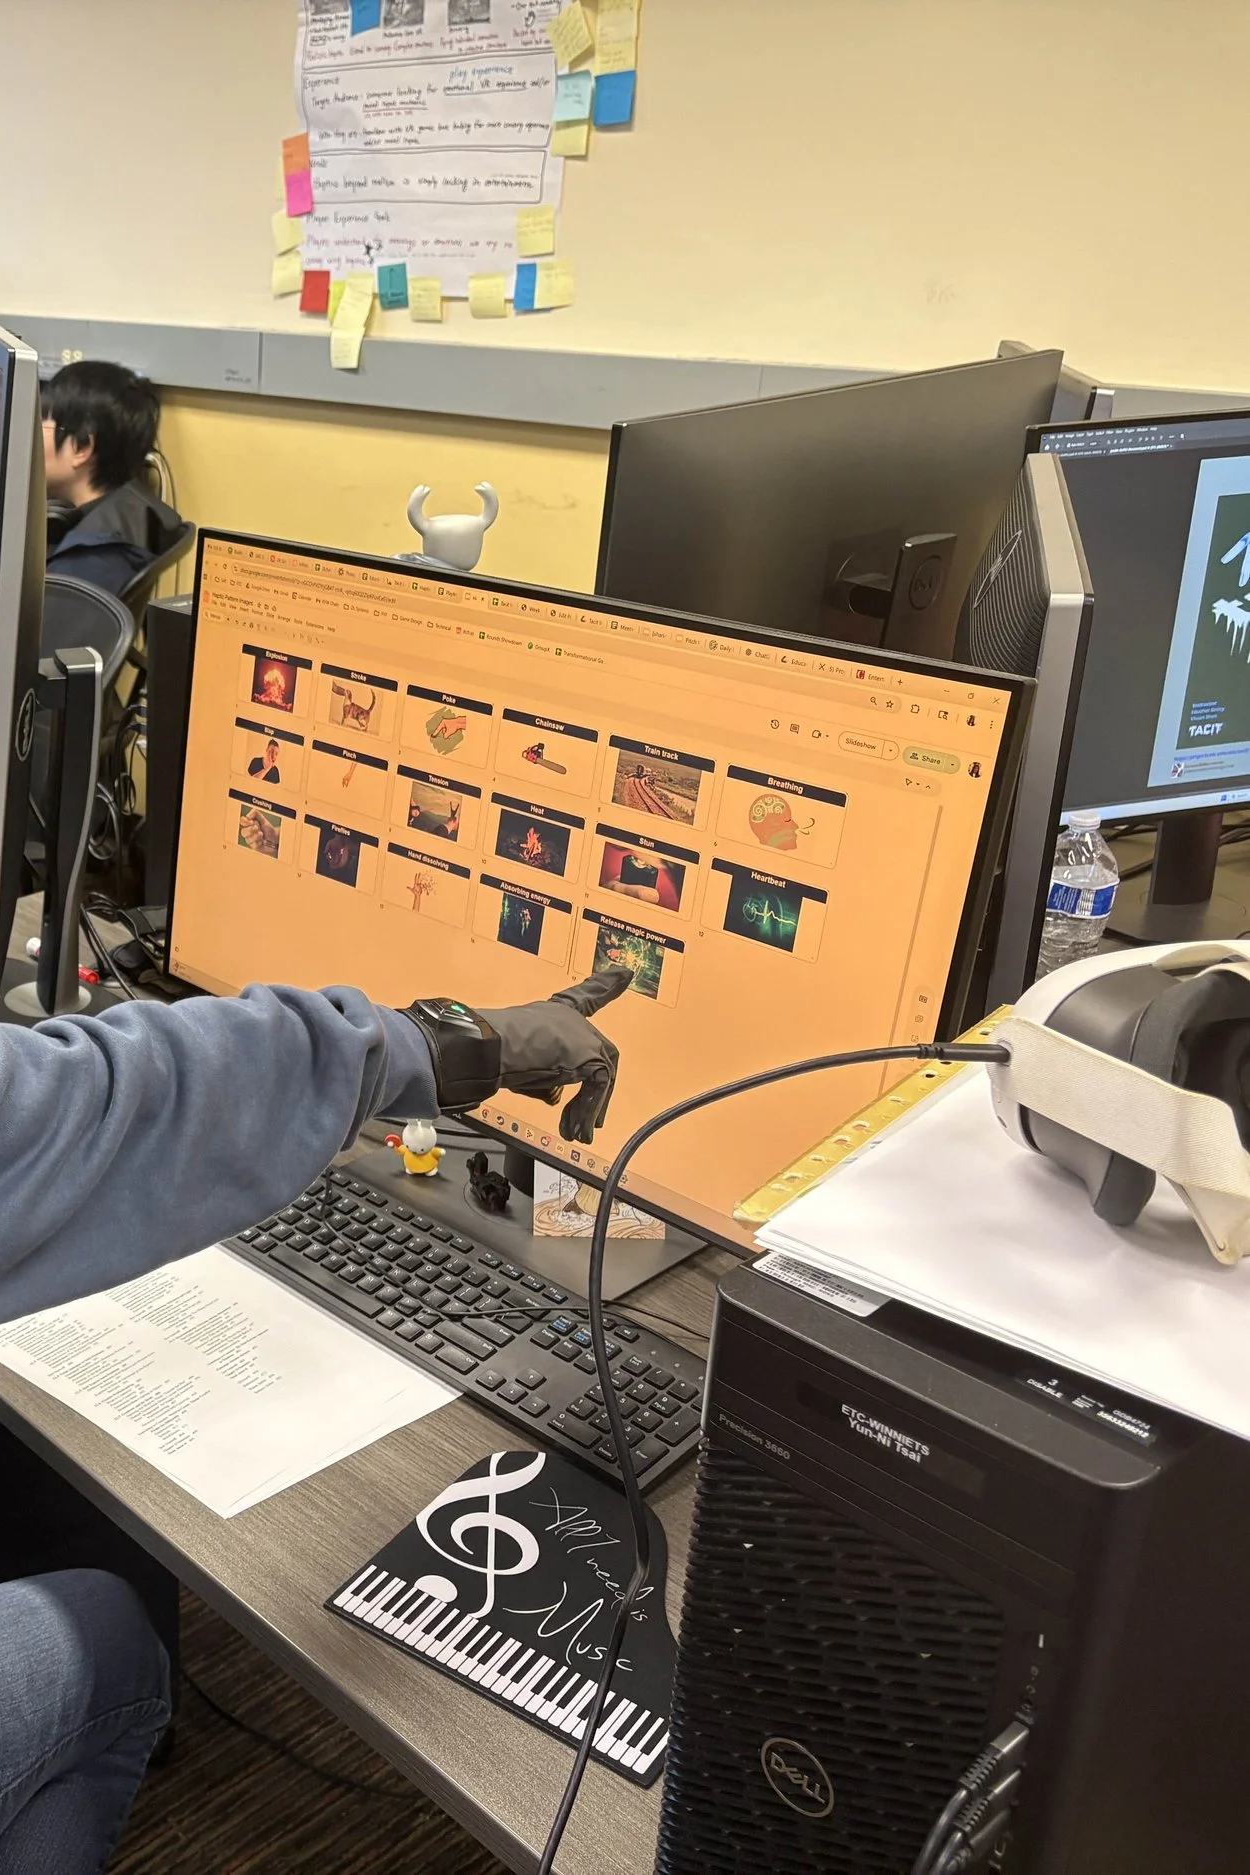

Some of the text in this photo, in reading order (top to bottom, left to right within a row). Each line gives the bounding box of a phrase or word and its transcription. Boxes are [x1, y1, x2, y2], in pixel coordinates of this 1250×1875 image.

[265, 651, 288, 662] Explosion
[350, 672, 367, 682] Stroke
[442, 694, 456, 704] Poke
[535, 718, 565, 731] Chainsaw
[1188, 722, 1224, 738] TACIT
[845, 738, 877, 750] Slideshow
[342, 750, 357, 760] Pinch
[644, 745, 680, 760] Train track
[921, 755, 941, 765] Share
[428, 775, 449, 787] Tension
[767, 777, 804, 794] Breathing
[530, 804, 545, 815] Heat
[639, 837, 655, 848] Stun
[407, 850, 449, 871] Hand dissolving
[751, 871, 786, 888] Heartbeat
[500, 882, 551, 906] Absorbing energy
[600, 916, 667, 945] Release magic power
[1027, 1378, 1064, 1399] DISABLE
[719, 1413, 791, 1460] Precision 3660
[841, 1403, 930, 1456] ETC-WINNIETS
[848, 1417, 922, 1464] Yun-Ni Tsai
[503, 1581, 633, 1672] Musc
[770, 1752, 826, 1805] DELL
